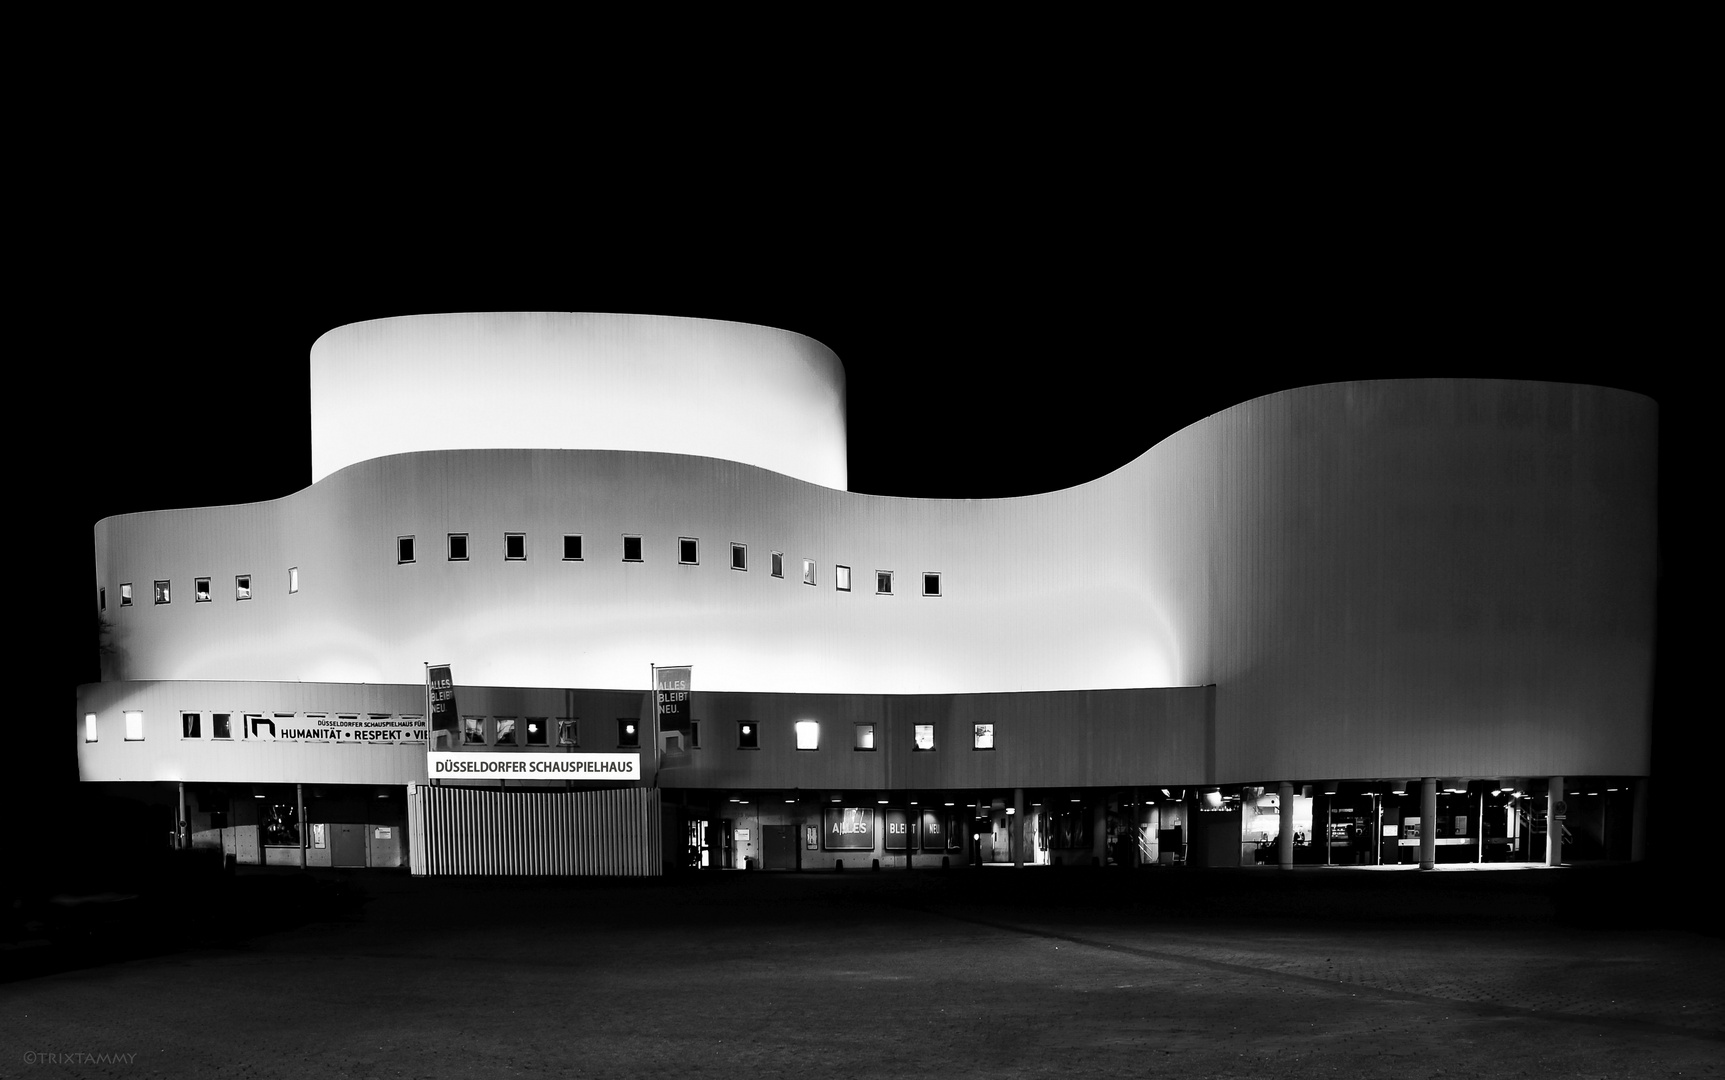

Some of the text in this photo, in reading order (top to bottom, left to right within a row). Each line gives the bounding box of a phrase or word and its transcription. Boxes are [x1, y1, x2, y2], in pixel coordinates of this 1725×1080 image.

[658, 680, 686, 690] ALLES
[658, 692, 688, 703] BLEIBT
[659, 704, 680, 714] NEU.
[318, 719, 426, 728] DÜSSELDORFER SCHAUSPIELHAUS FÜR
[281, 728, 342, 740] HUMANITÄT
[354, 730, 402, 740] RESPEKT
[435, 759, 633, 773] DÜSSELDORFER SCHAUSPIELHAUS
